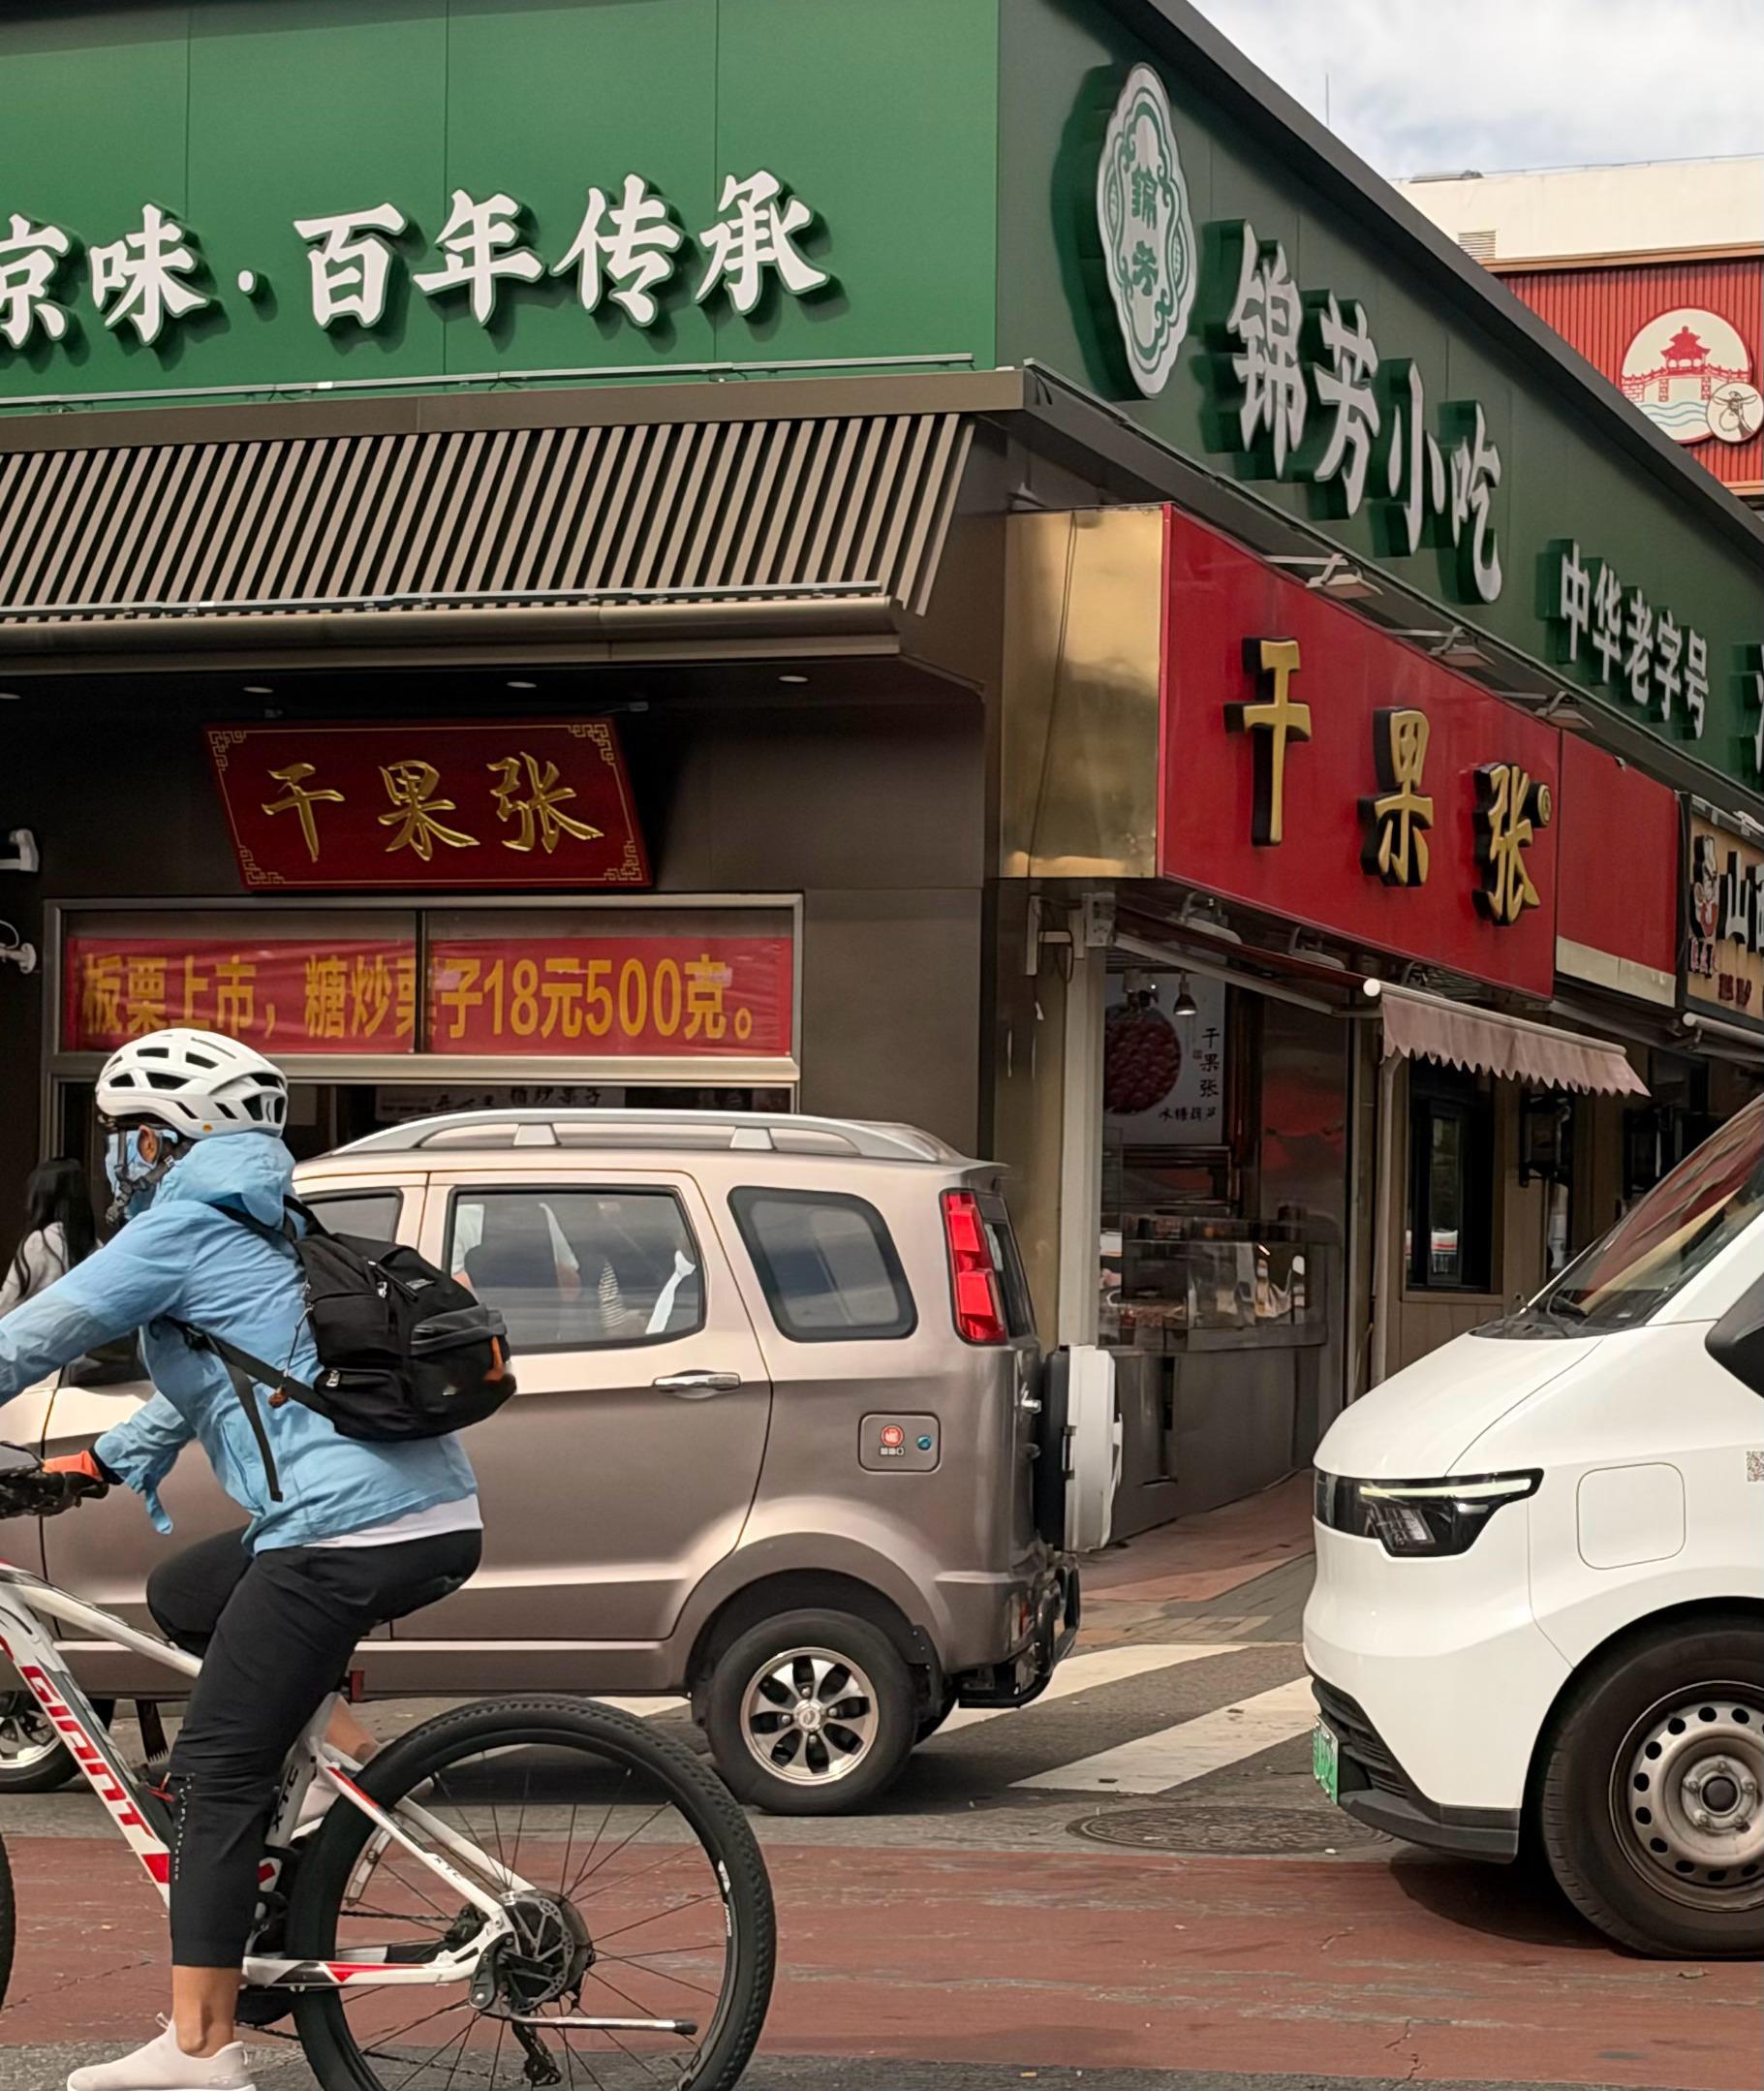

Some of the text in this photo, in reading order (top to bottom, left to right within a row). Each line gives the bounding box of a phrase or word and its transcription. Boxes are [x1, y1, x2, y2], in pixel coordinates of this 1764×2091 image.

[1226, 222, 1502, 603] 锦芳小吃
[1560, 543, 1710, 739] 中华老字号
[262, 751, 605, 862] 干果张
[1243, 638, 1542, 924] 干果张
[1199, 1027, 1221, 1098] 干果张
[18, 1665, 157, 1841] GIANT
